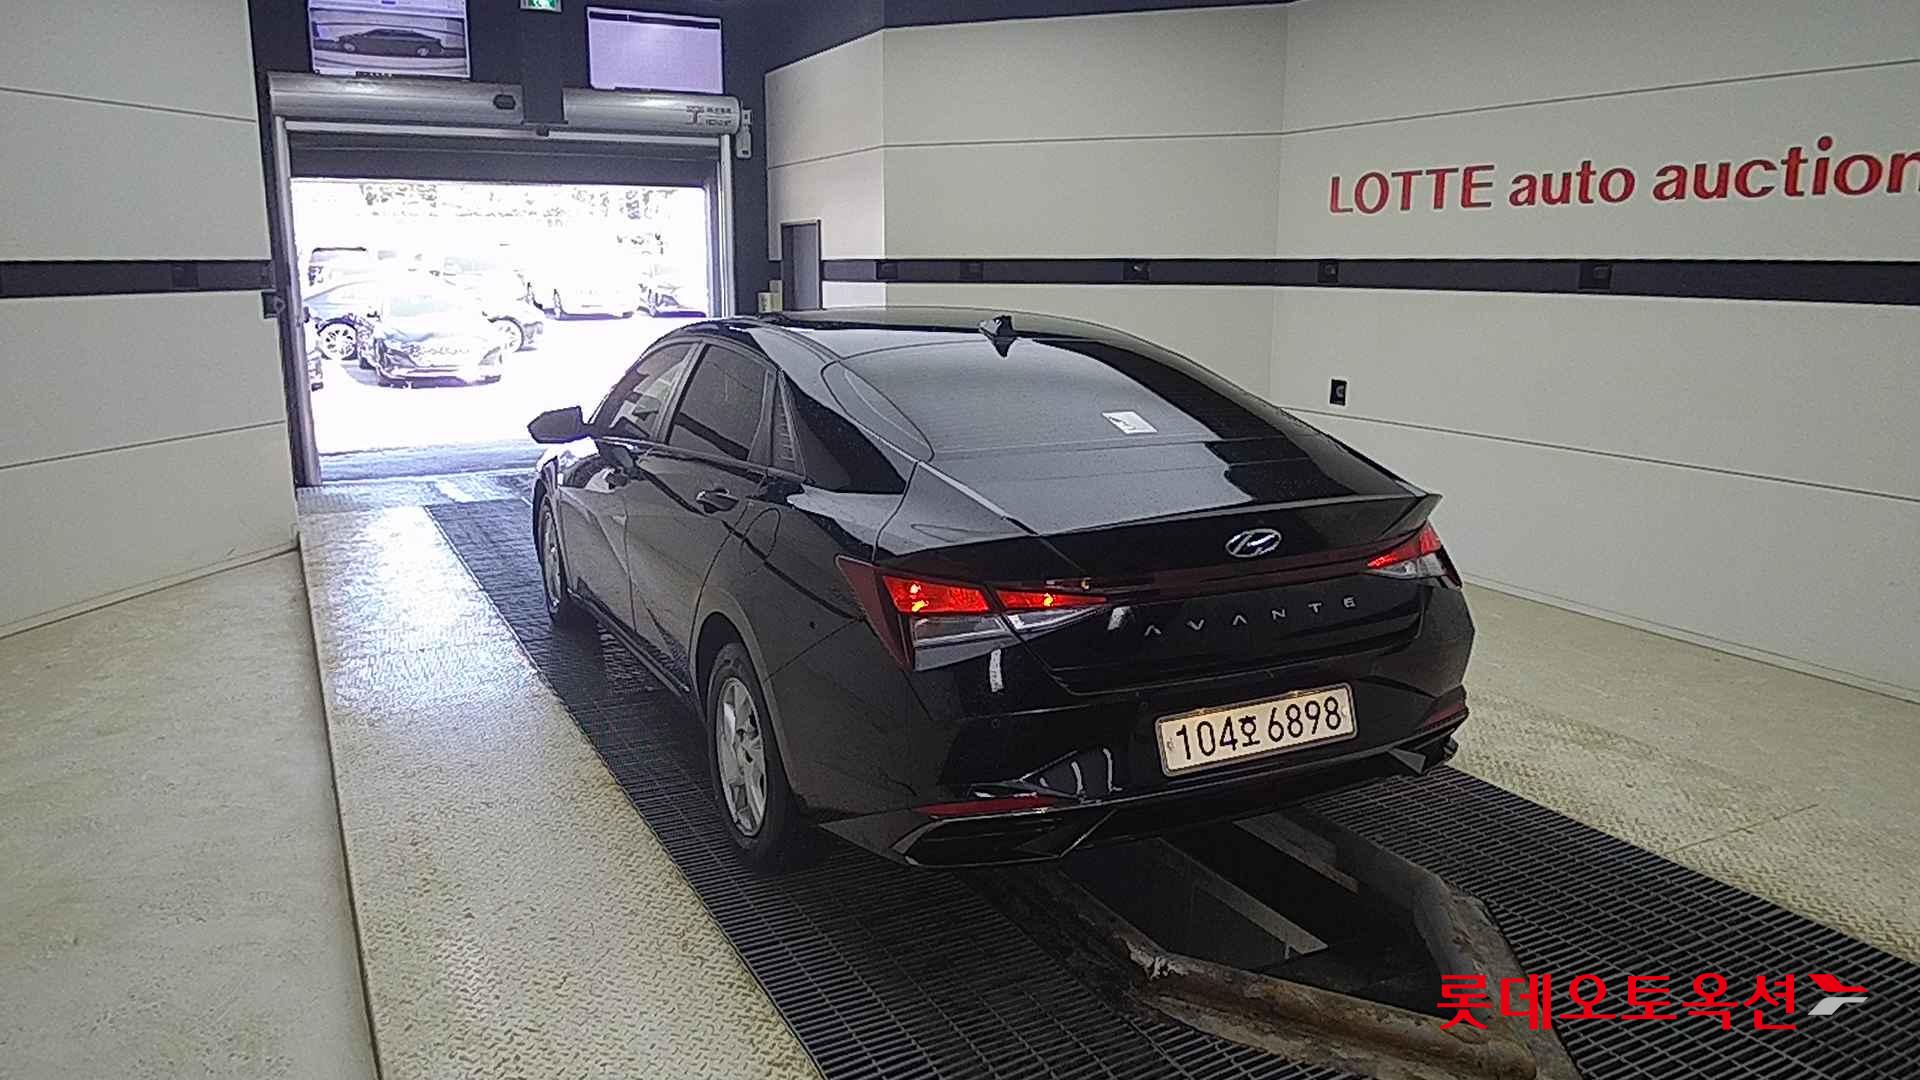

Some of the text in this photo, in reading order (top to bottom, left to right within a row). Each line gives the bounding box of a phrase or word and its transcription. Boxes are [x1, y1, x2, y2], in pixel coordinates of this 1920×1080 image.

[1330, 135, 1920, 214] LOTTE auto auction
[1143, 597, 1357, 637] AVANTE
